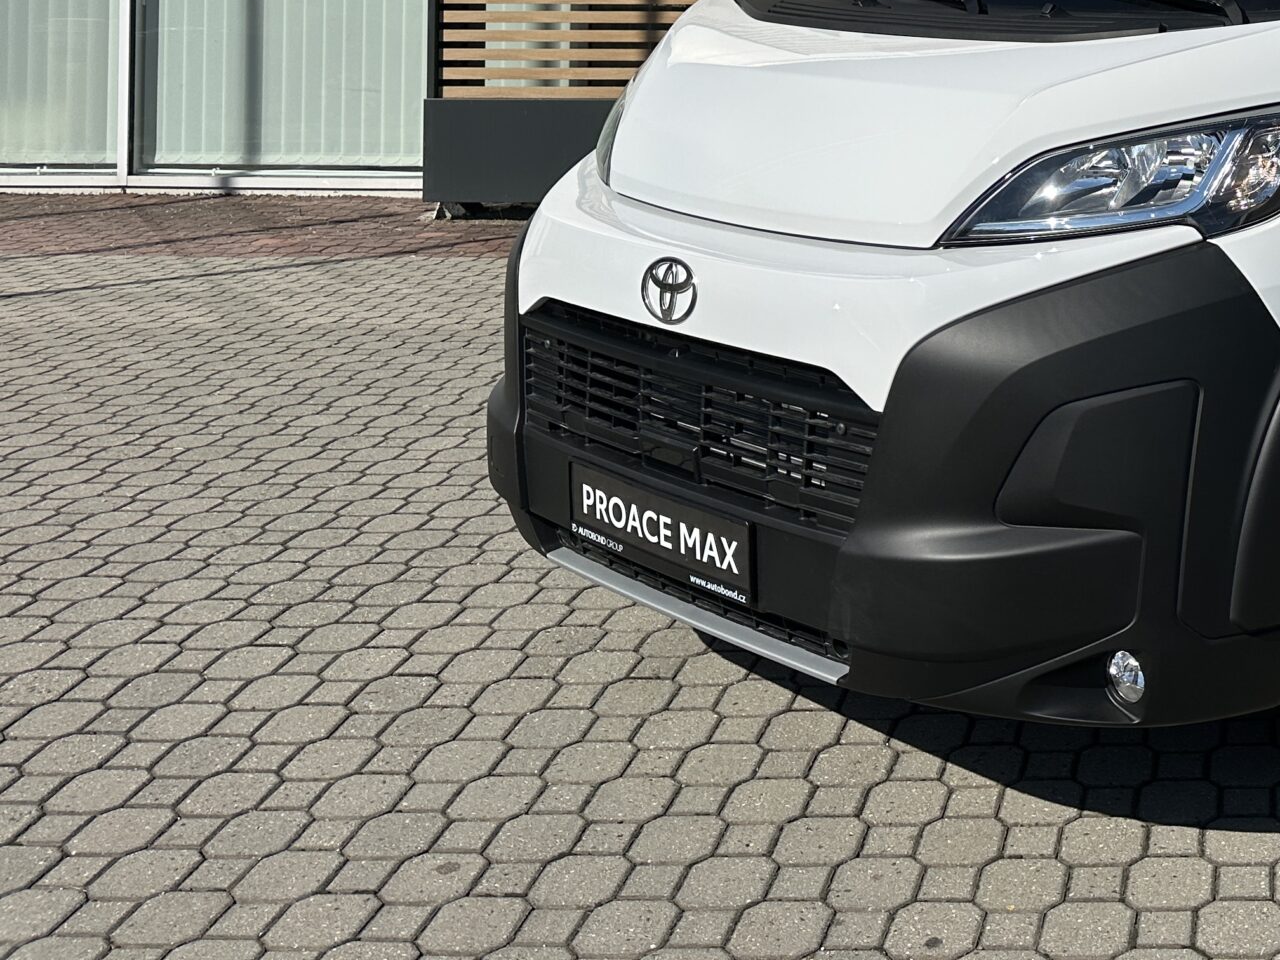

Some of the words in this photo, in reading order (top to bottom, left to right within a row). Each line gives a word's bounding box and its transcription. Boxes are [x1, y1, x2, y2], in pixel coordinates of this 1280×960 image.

[578, 526, 606, 545] AUTOBOND
[606, 539, 624, 552] GROUP
[582, 483, 673, 550] PROACE
[679, 522, 739, 574] MAX
[689, 575, 747, 603] www.autobond.cz
